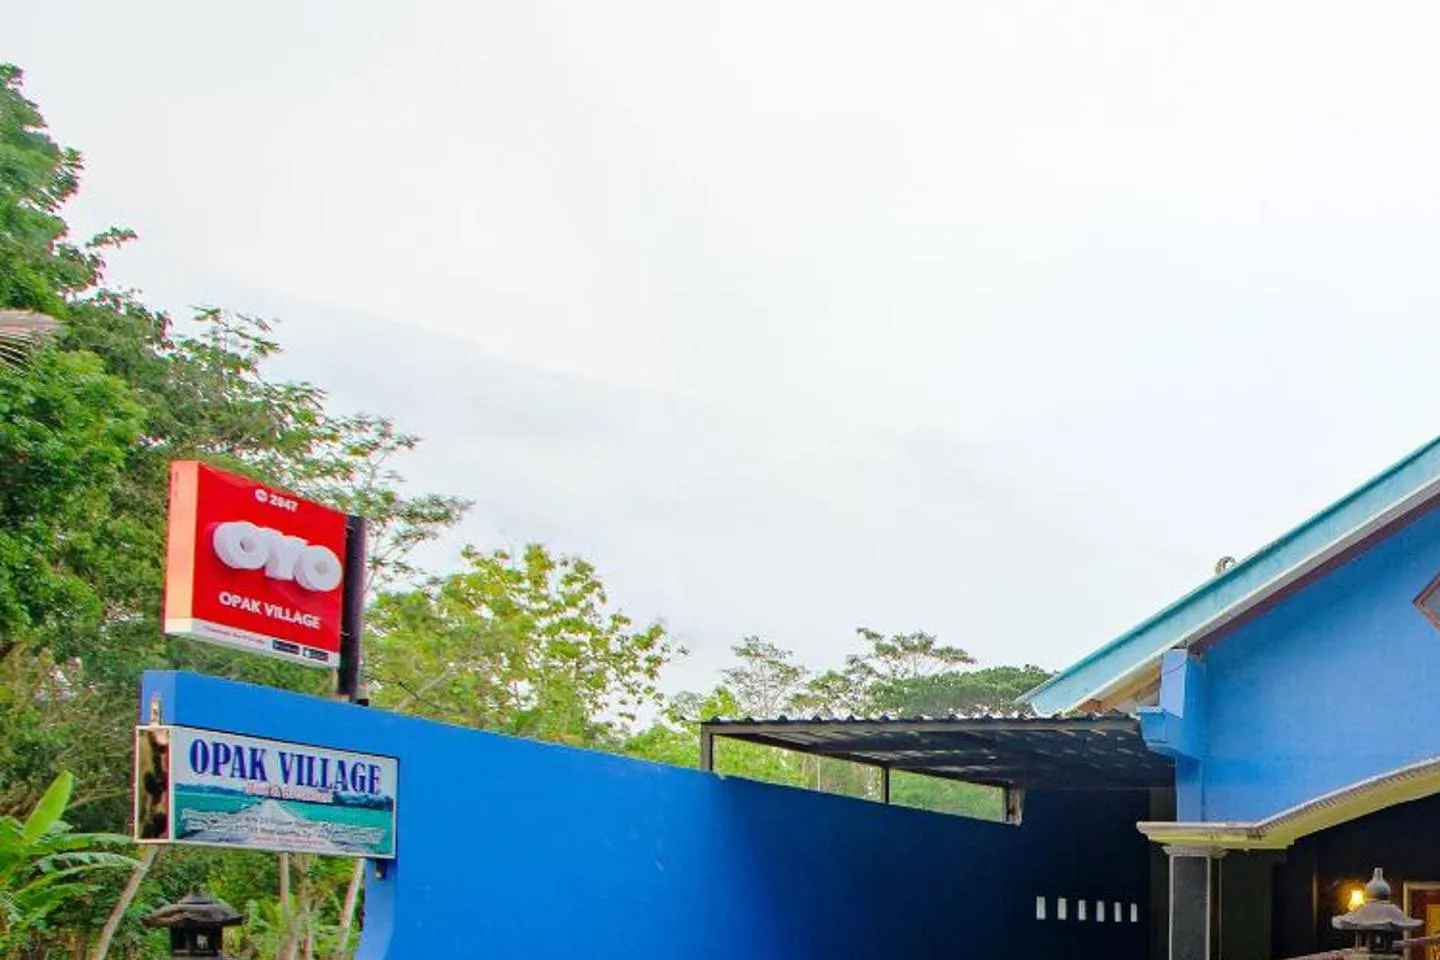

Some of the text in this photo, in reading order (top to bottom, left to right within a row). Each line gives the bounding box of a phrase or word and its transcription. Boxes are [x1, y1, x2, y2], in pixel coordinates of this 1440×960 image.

[213, 521, 342, 591] OYO
[219, 591, 321, 629] OPAK VILLAGE
[190, 738, 267, 782] OPAK
[279, 751, 382, 794] VILLAGE
